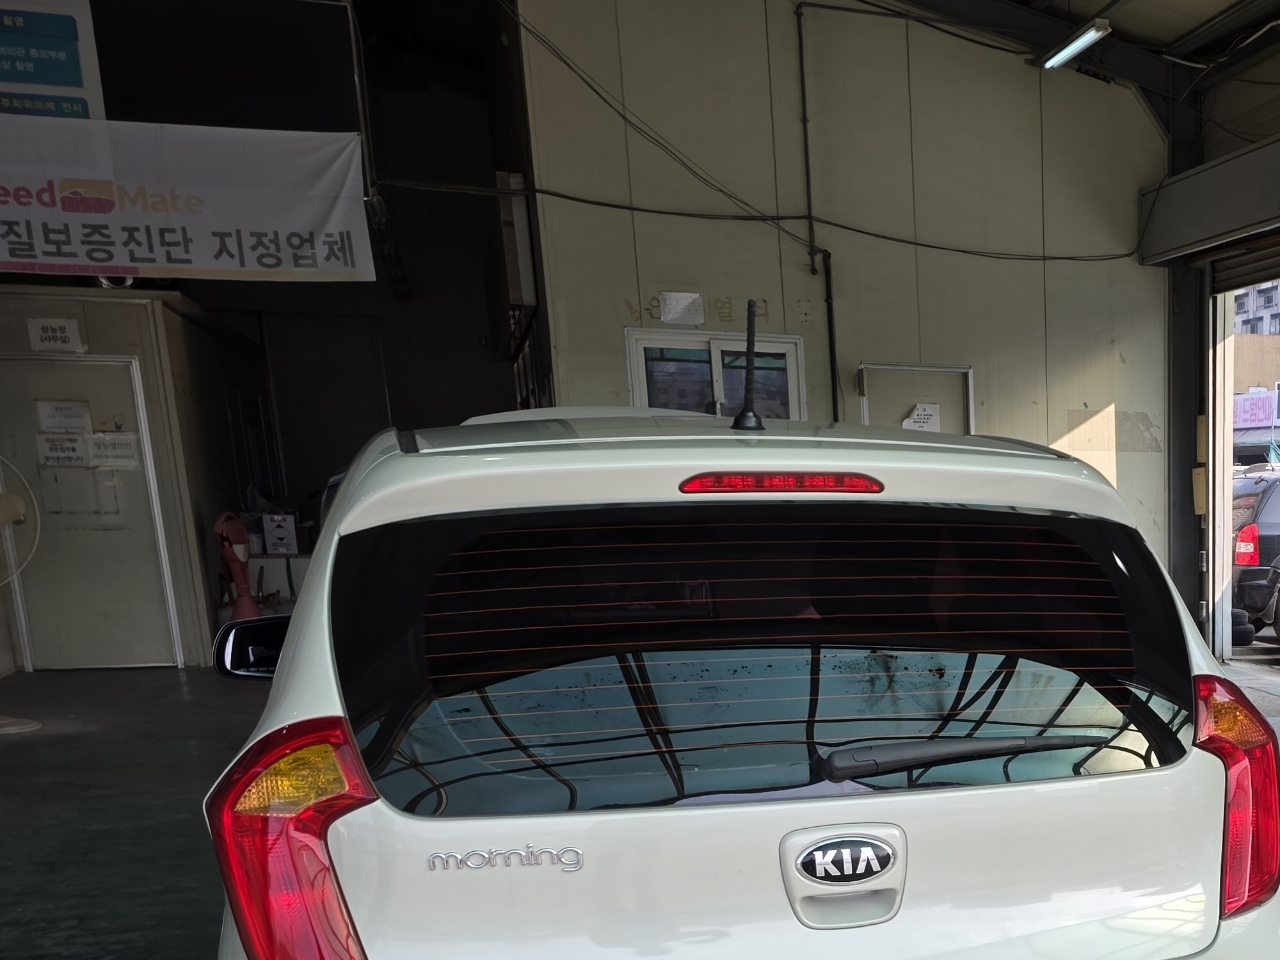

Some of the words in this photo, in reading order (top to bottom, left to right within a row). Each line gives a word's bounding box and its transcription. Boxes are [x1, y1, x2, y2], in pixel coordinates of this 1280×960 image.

[117, 184, 205, 215] Mate
[0, 219, 194, 264] 질보증진단
[211, 229, 357, 269] 지정업체
[40, 335, 70, 344] (사무실)
[428, 843, 585, 872] morning
[812, 846, 882, 877] KIA
